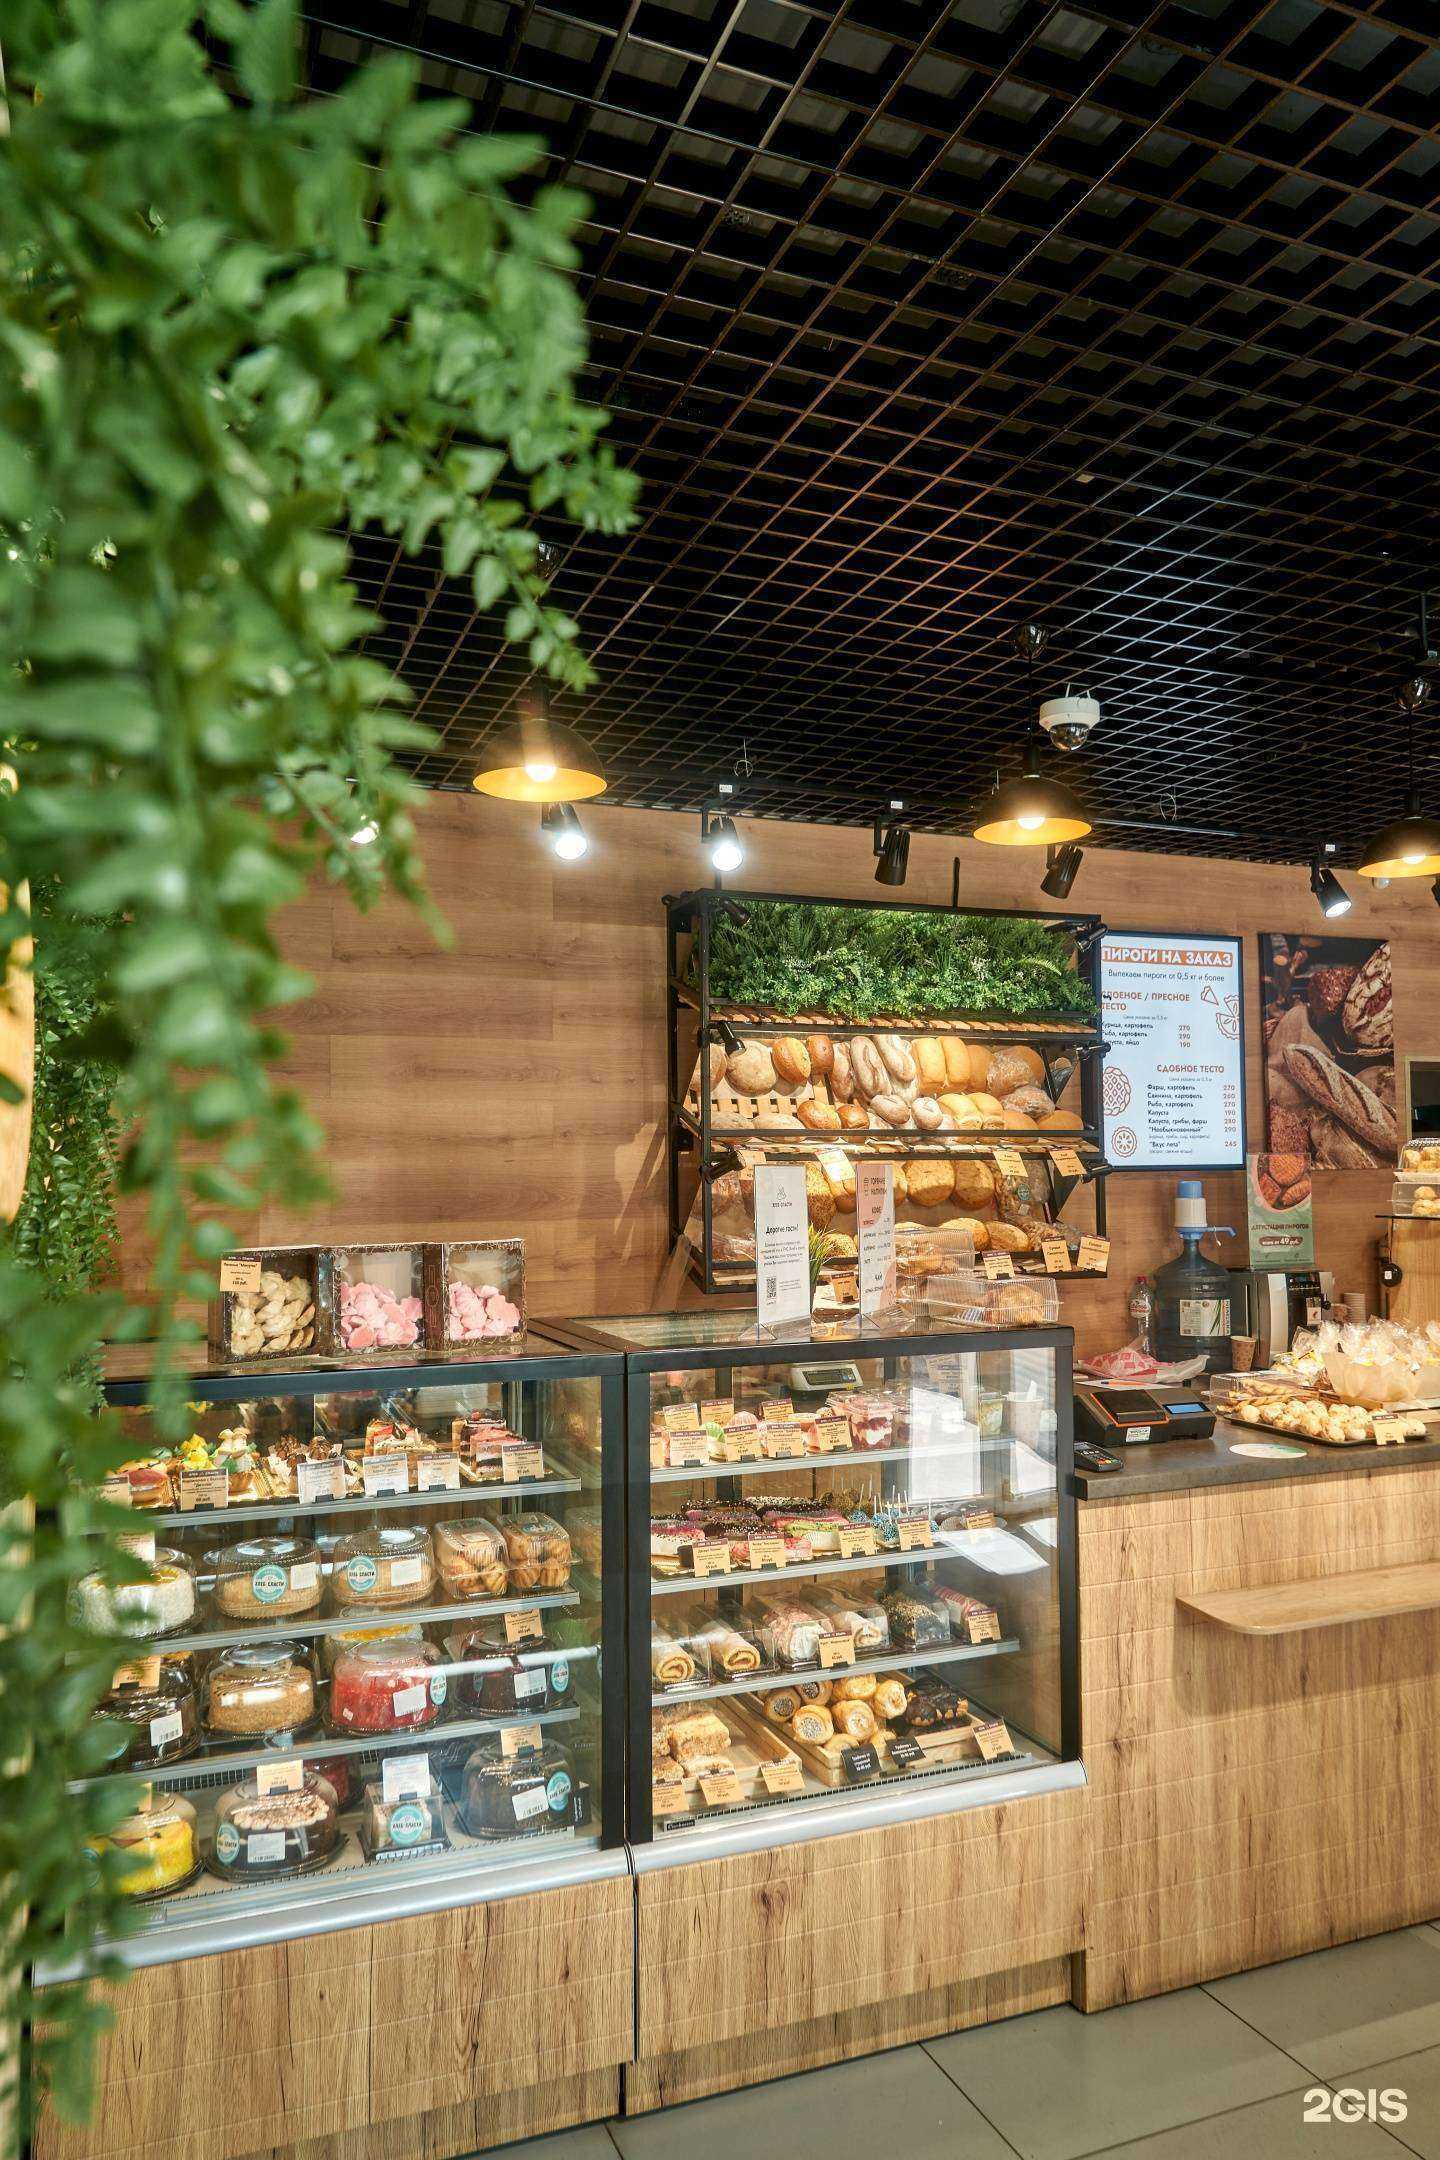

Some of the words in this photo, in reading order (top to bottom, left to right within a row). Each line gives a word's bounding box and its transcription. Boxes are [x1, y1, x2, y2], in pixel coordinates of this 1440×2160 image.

[1102, 946, 1158, 961] ПИРОГИ
[1162, 949, 1182, 963] НА
[1186, 951, 1232, 965] ЗАКАЗ
[1108, 969, 1141, 978] Выпекаем
[1143, 971, 1167, 980] пироги
[1177, 973, 1189, 981] 0,5
[1204, 973, 1225, 981] более
[1151, 993, 1190, 1001] ПРЕСНОЕ
[1101, 1002, 1127, 1011] ТЕСТО
[1280, 1237, 1290, 1245] 49
